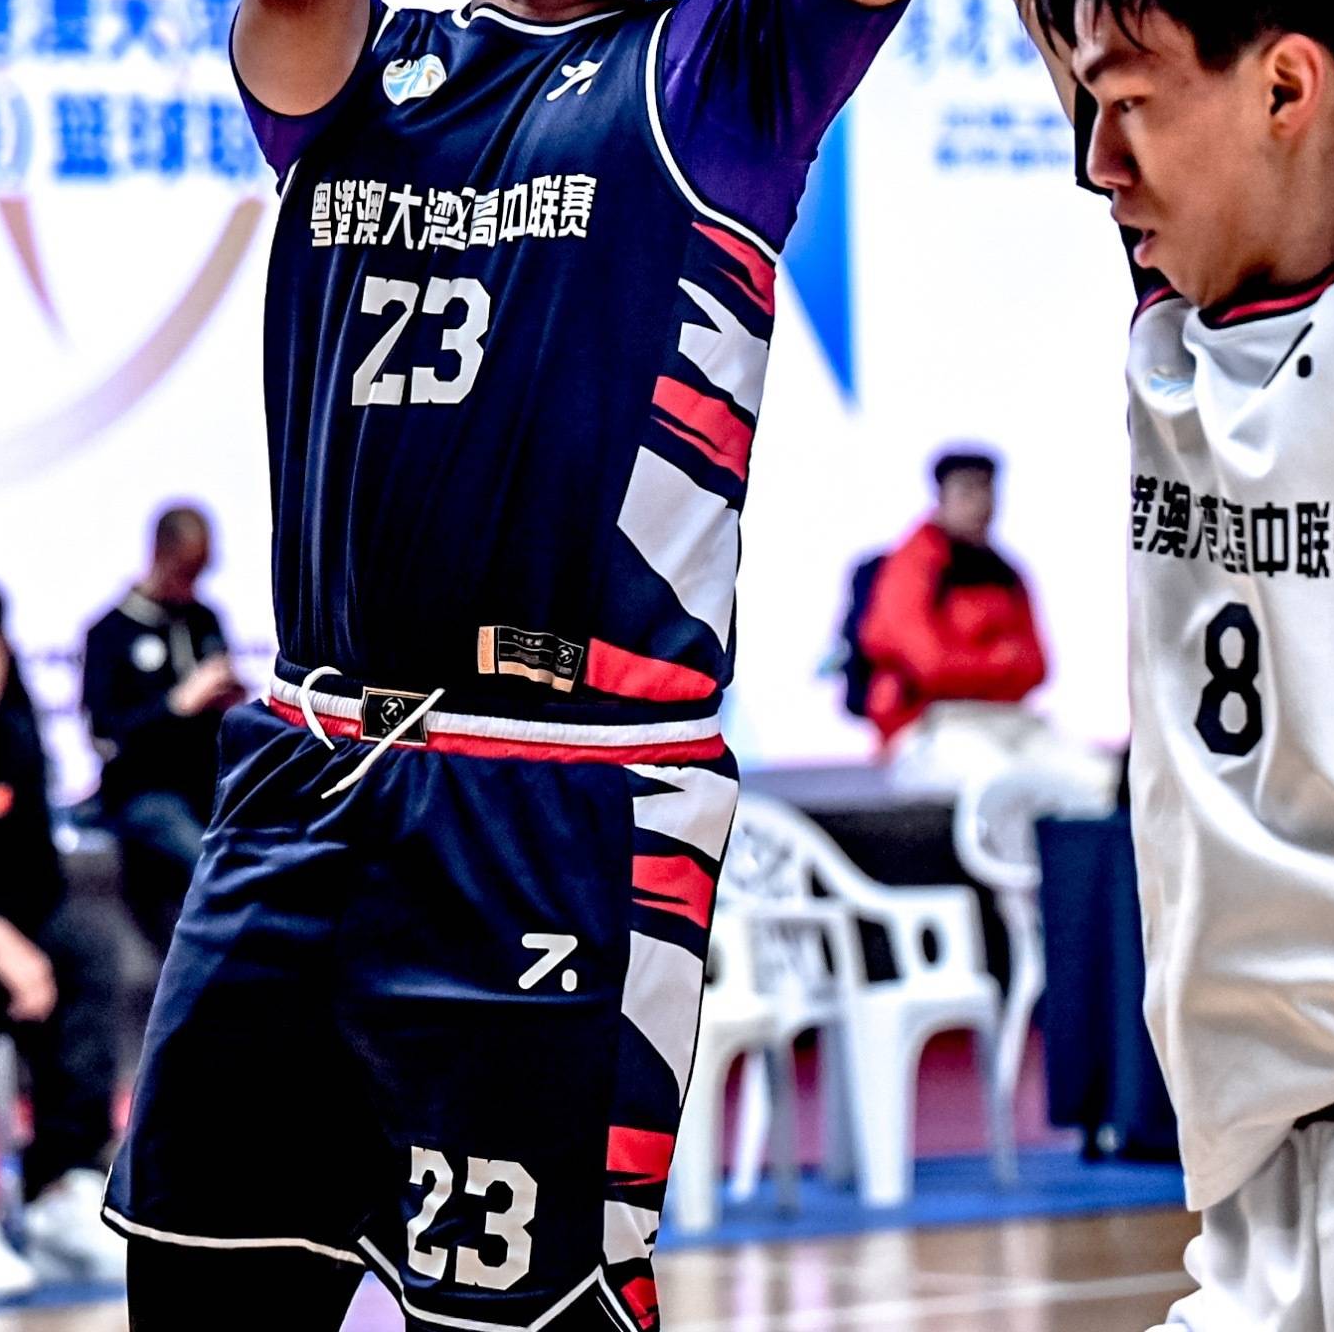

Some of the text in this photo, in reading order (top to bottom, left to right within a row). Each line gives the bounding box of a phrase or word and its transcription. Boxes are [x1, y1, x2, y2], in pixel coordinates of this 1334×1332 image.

[310, 174, 597, 252] 粤港澳大湾区高中联赛
[352, 276, 491, 406] 23
[1194, 602, 1263, 757] 8
[403, 1144, 539, 1291] 23
